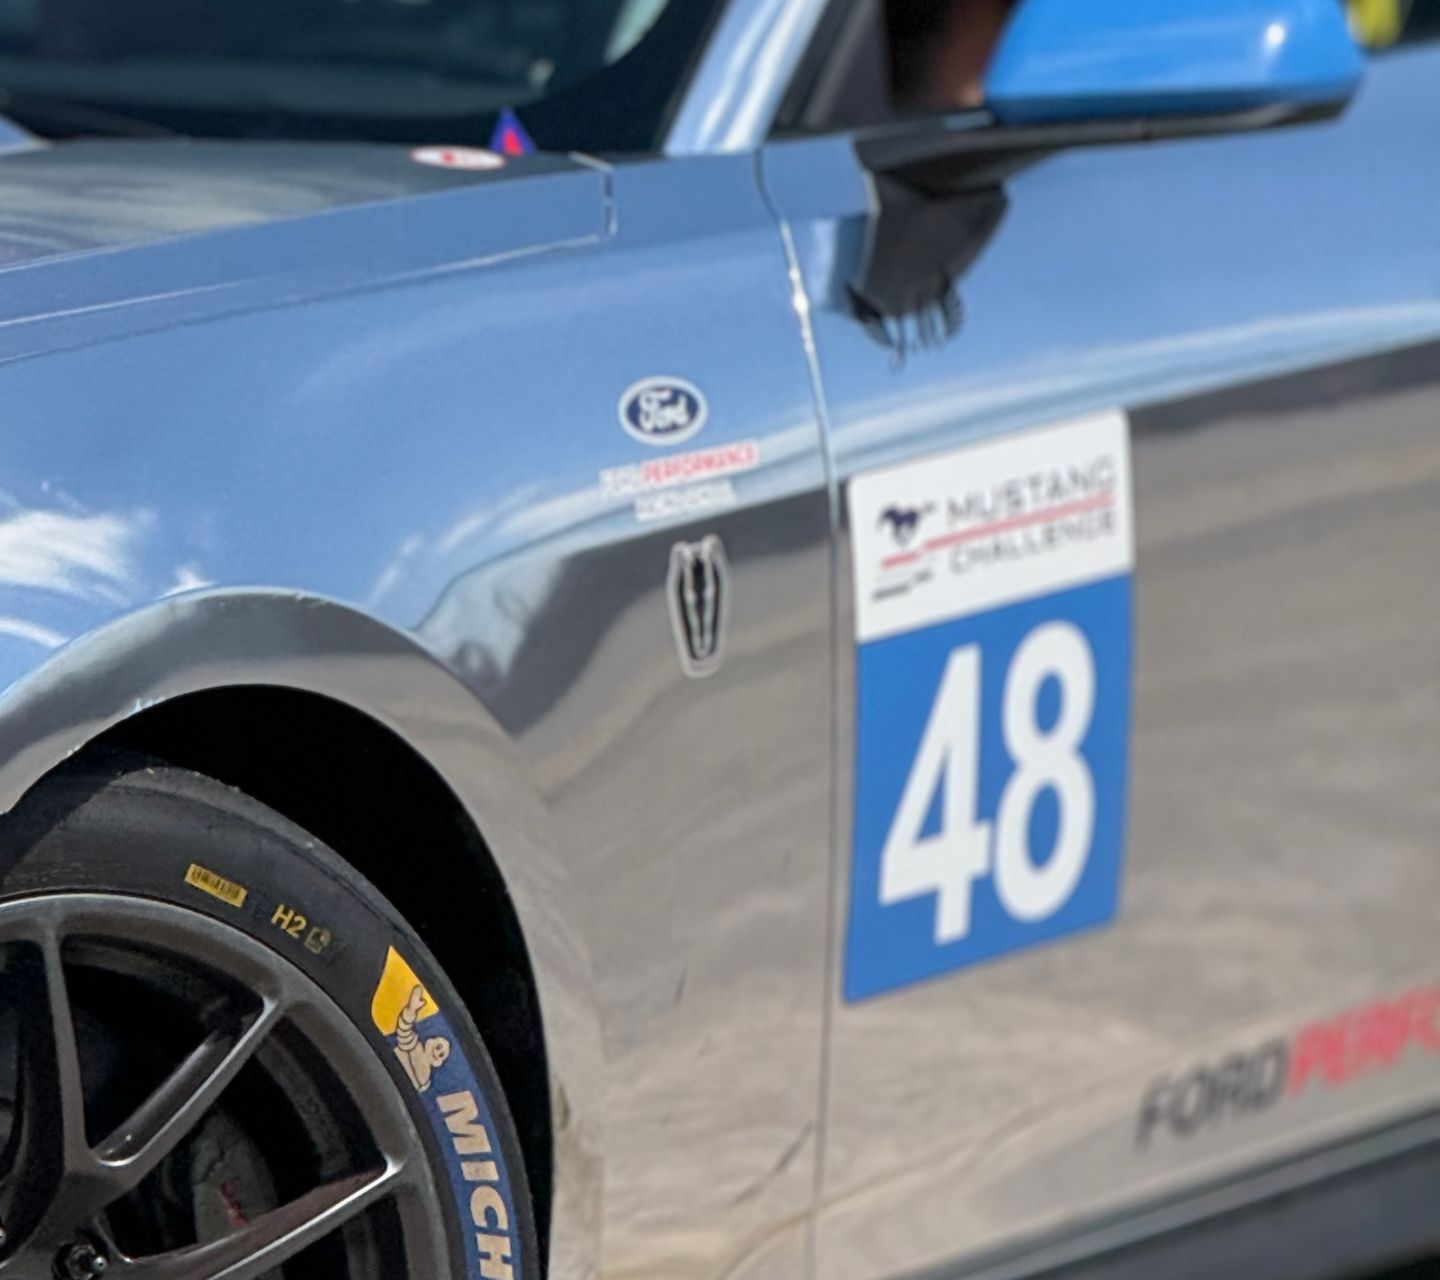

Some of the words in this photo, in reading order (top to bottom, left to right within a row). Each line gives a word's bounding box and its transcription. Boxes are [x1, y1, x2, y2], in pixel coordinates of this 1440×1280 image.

[946, 454, 1115, 524] MUSTANG
[949, 510, 1115, 576] CHALLENGE
[878, 618, 1096, 946] 48
[269, 903, 308, 940] H2
